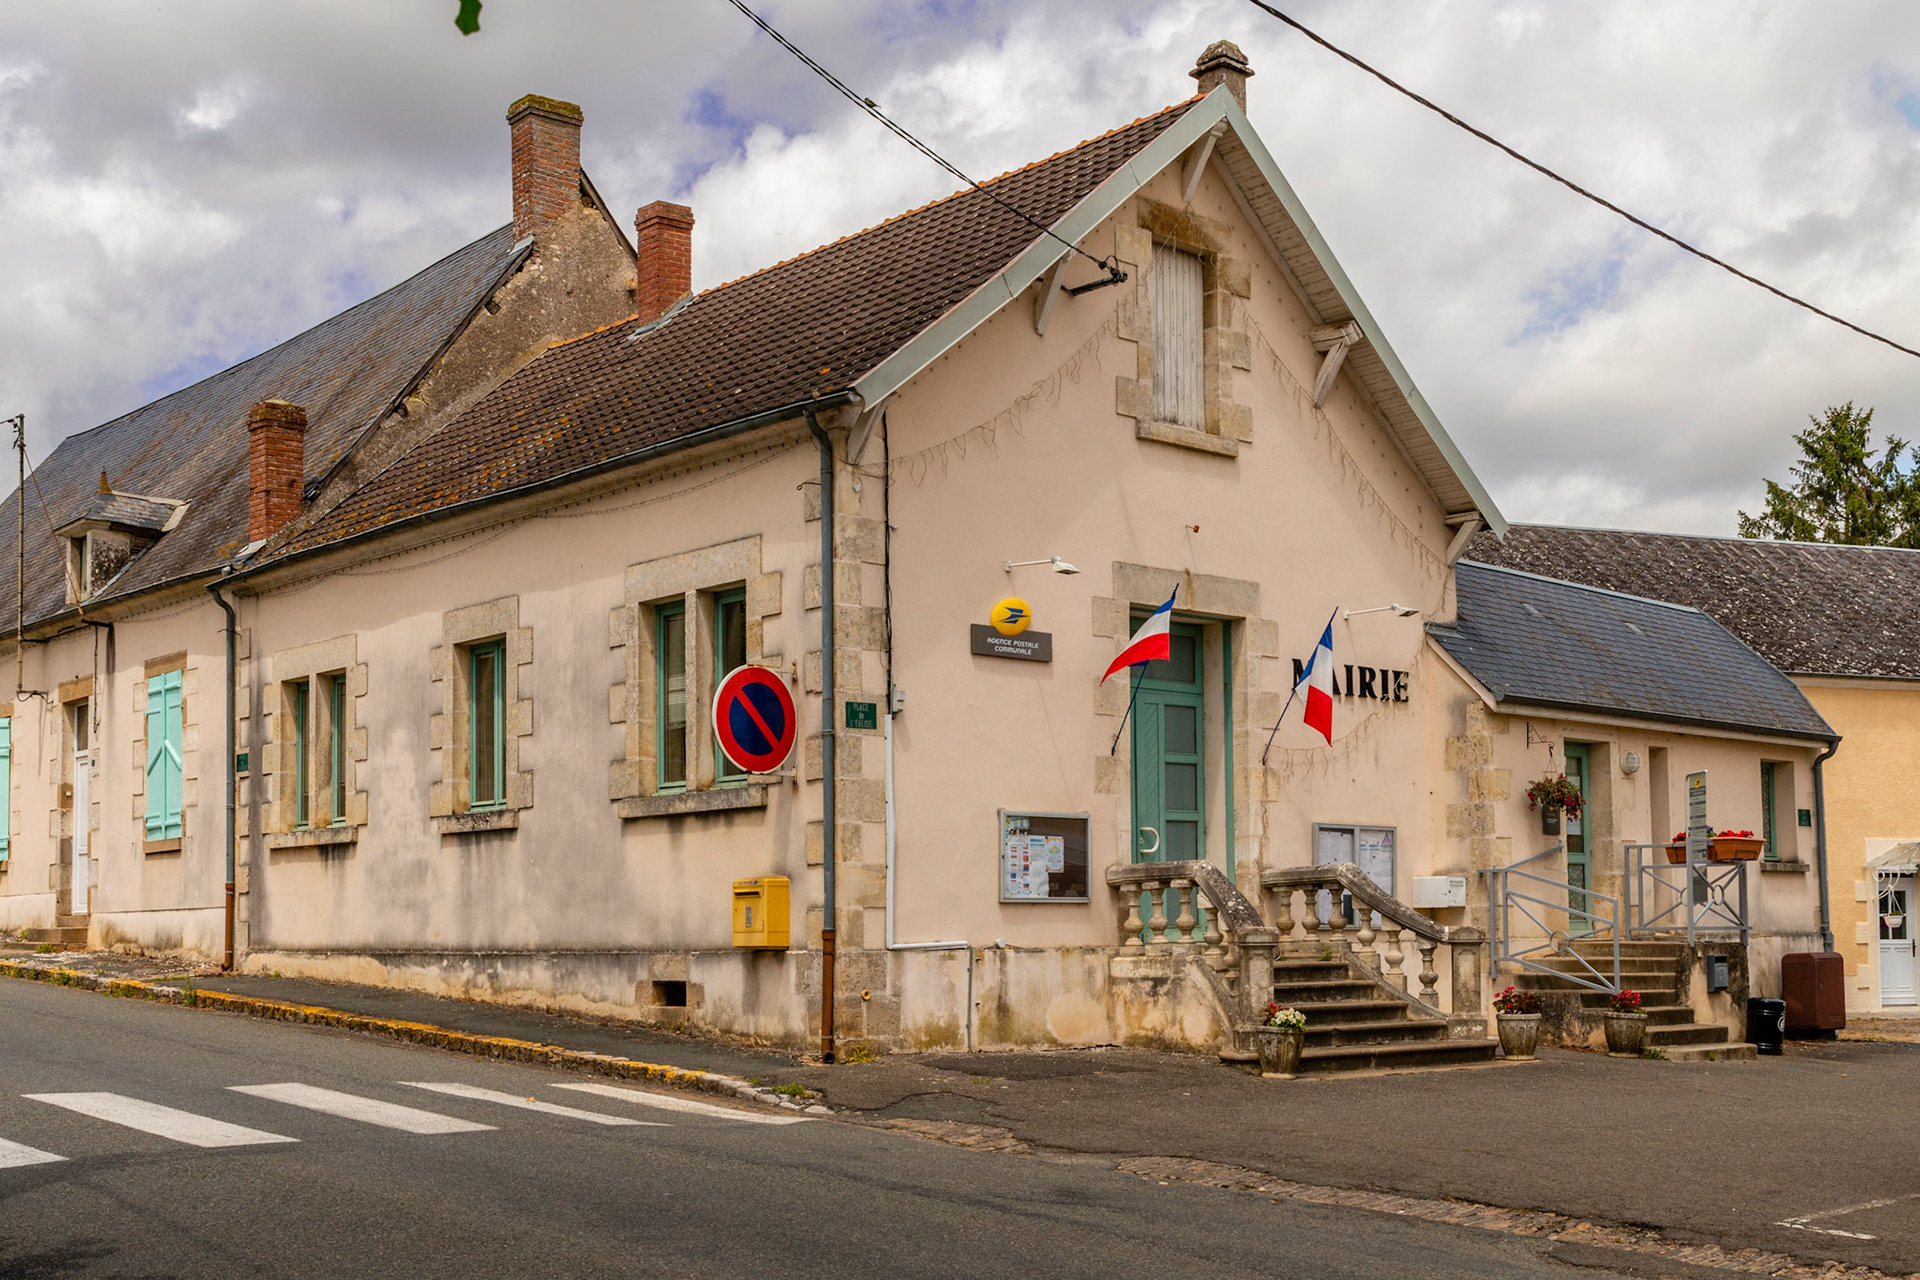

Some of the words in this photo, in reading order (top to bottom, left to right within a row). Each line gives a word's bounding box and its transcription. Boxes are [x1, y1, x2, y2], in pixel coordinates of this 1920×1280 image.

[986, 637, 1012, 646] AGENCE
[1013, 640, 1039, 649] POSTALE
[994, 645, 1032, 655] COMMUNALE
[853, 703, 869, 711] PLACE
